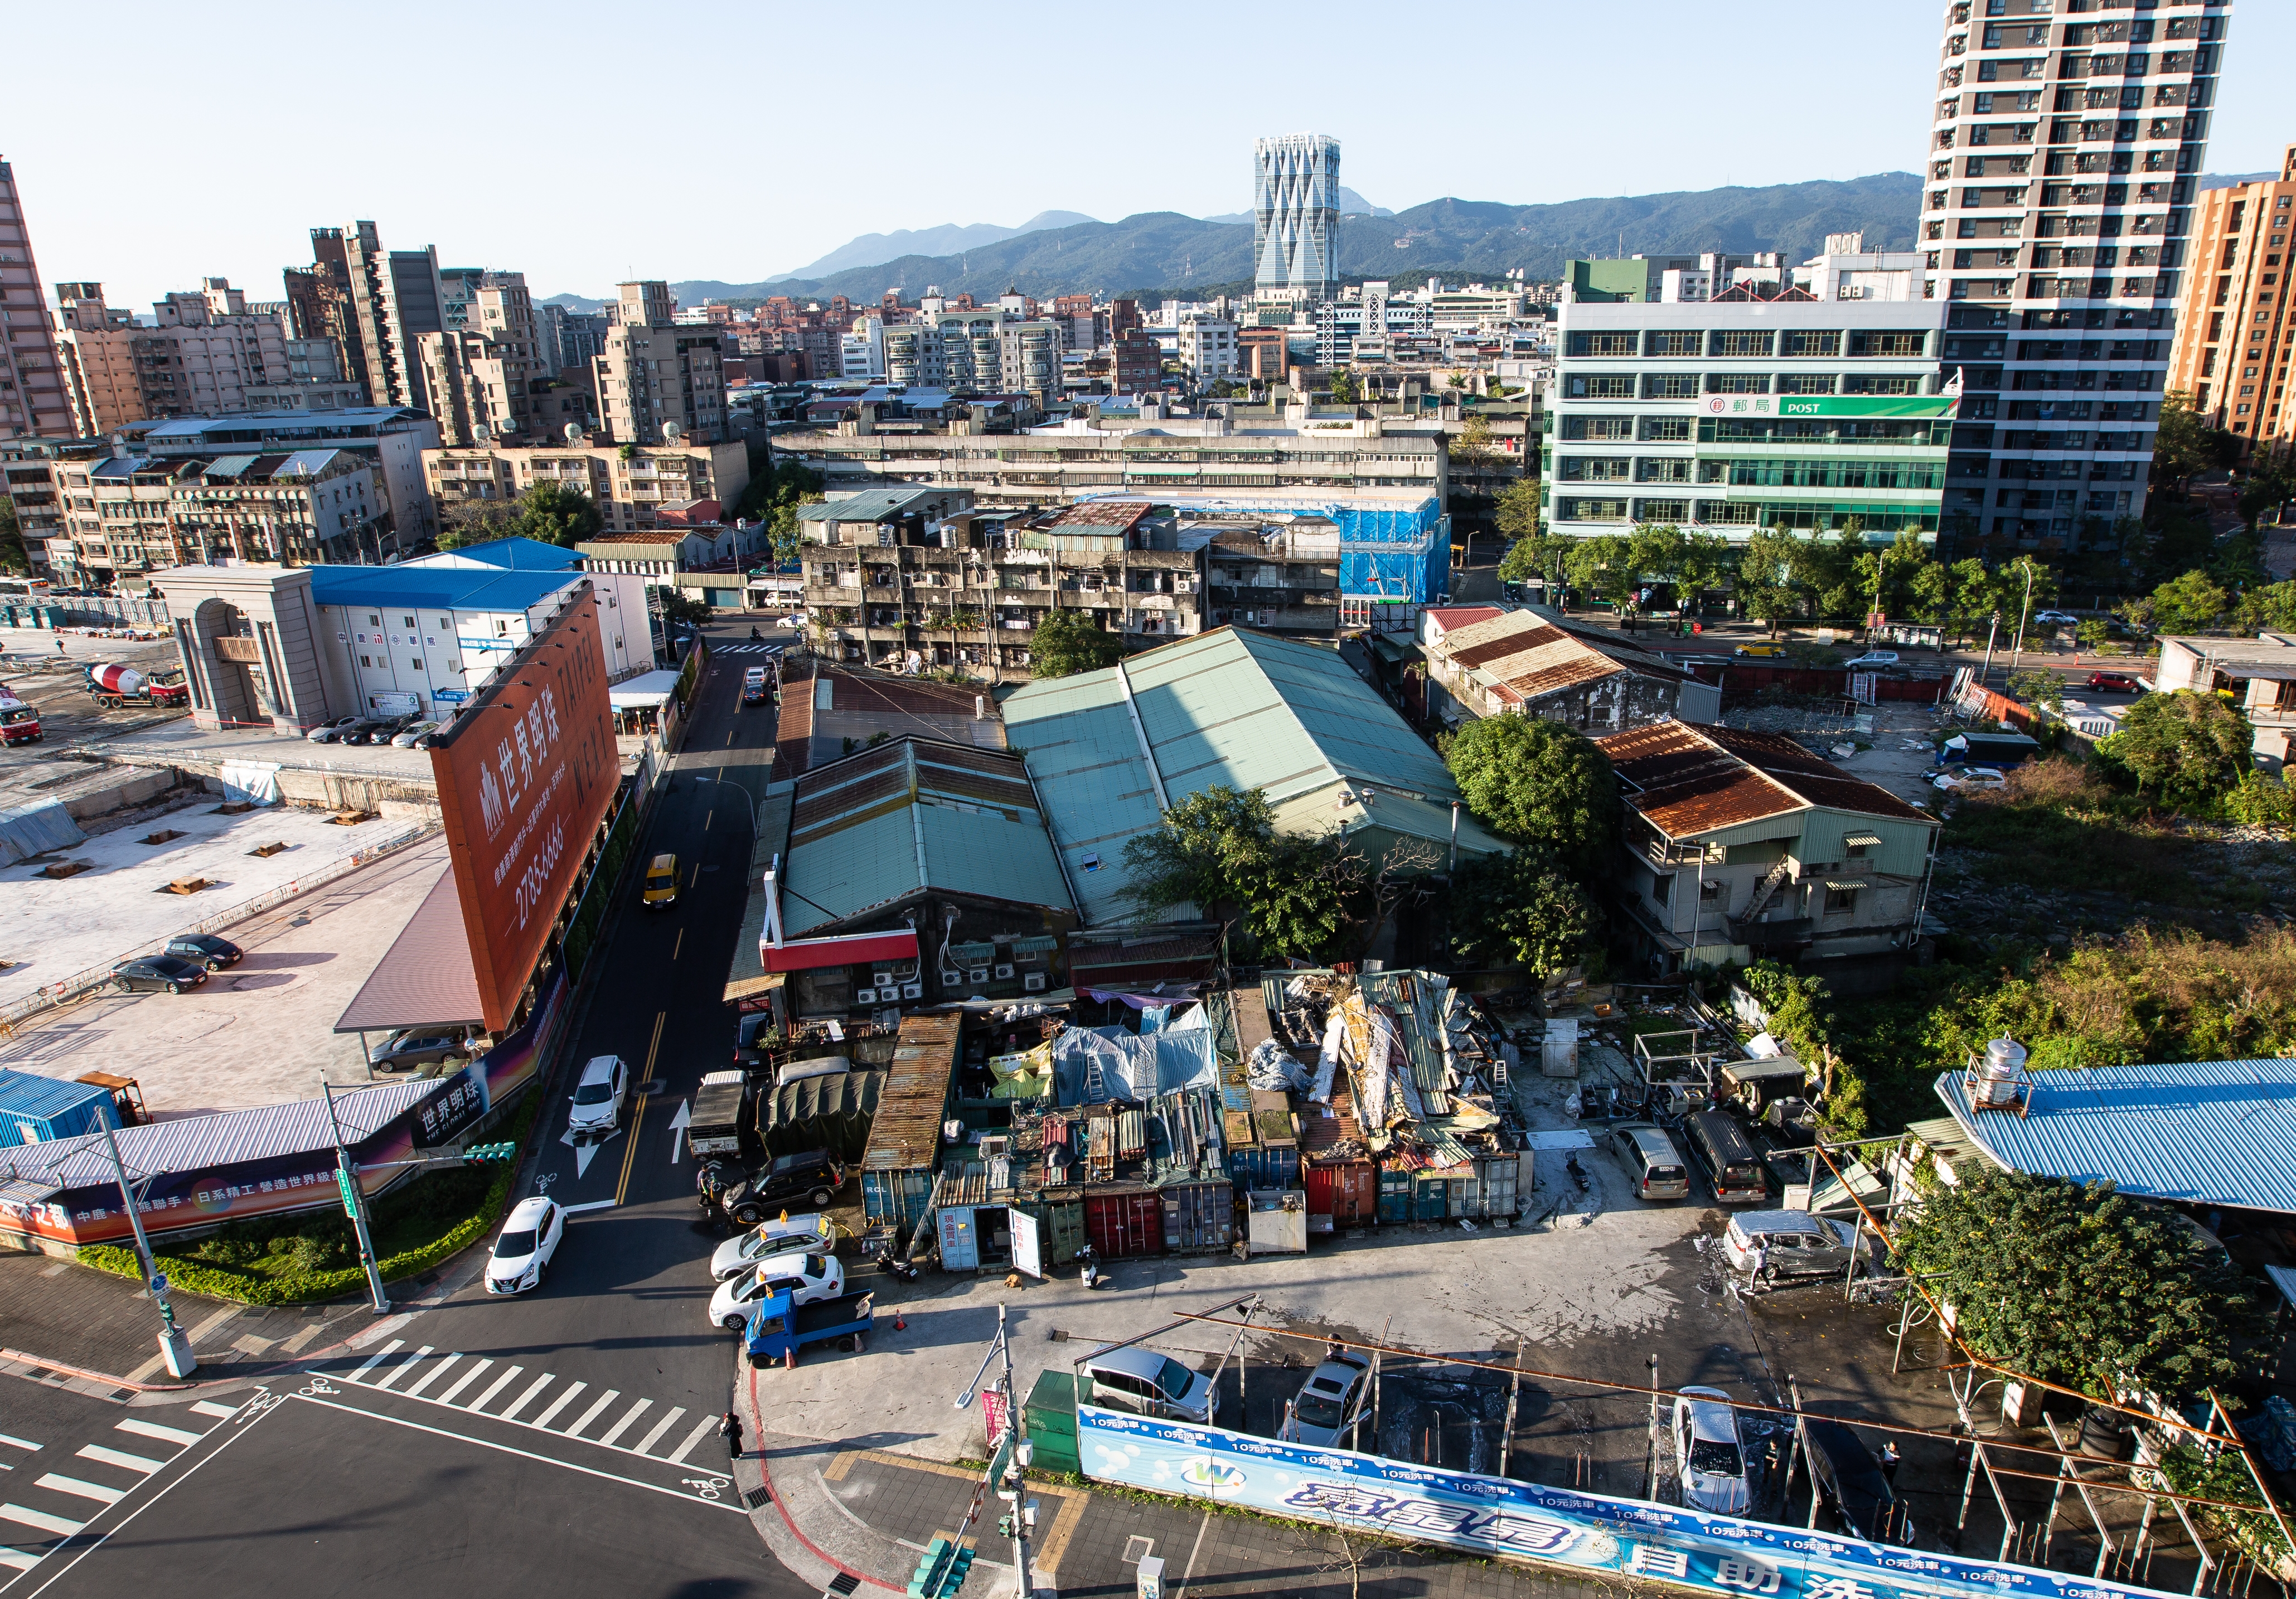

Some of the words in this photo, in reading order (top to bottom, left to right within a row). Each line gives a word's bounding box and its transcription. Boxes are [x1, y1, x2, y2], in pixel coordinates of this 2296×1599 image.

[1732, 399, 1770, 413] 郵局
[1788, 403, 1820, 414] POST
[558, 631, 596, 719] TAIPEI
[497, 683, 560, 815] 世界明珠
[573, 715, 606, 810] NEXT
[516, 813, 564, 931] 2785-6666
[422, 1078, 479, 1133] 世界明珠
[427, 1128, 439, 1142] THE
[442, 1110, 466, 1132] GLOBAL
[468, 1098, 481, 1112] ONE
[944, 1215, 956, 1247] 現金買車
[1090, 1418, 1140, 1429] 10元洗車
[1156, 1429, 1207, 1442] 10元洗車
[1231, 1442, 1284, 1455] 10元洗車
[1301, 1455, 1354, 1467] 10元洗車
[1380, 1469, 1436, 1481] 10元洗車
[1453, 1482, 1510, 1495] 10元洗車
[1538, 1497, 1596, 1510] 10元洗車
[1614, 1510, 1674, 1523] 10元洗車
[1703, 1525, 1764, 1539] 10元洗車
[1783, 1539, 1845, 1553] 10元洗車
[1631, 1544, 1950, 1599] 自助洗
[1875, 1558, 1940, 1571] 10元洗車
[1960, 1571, 2026, 1585] 10元洗車
